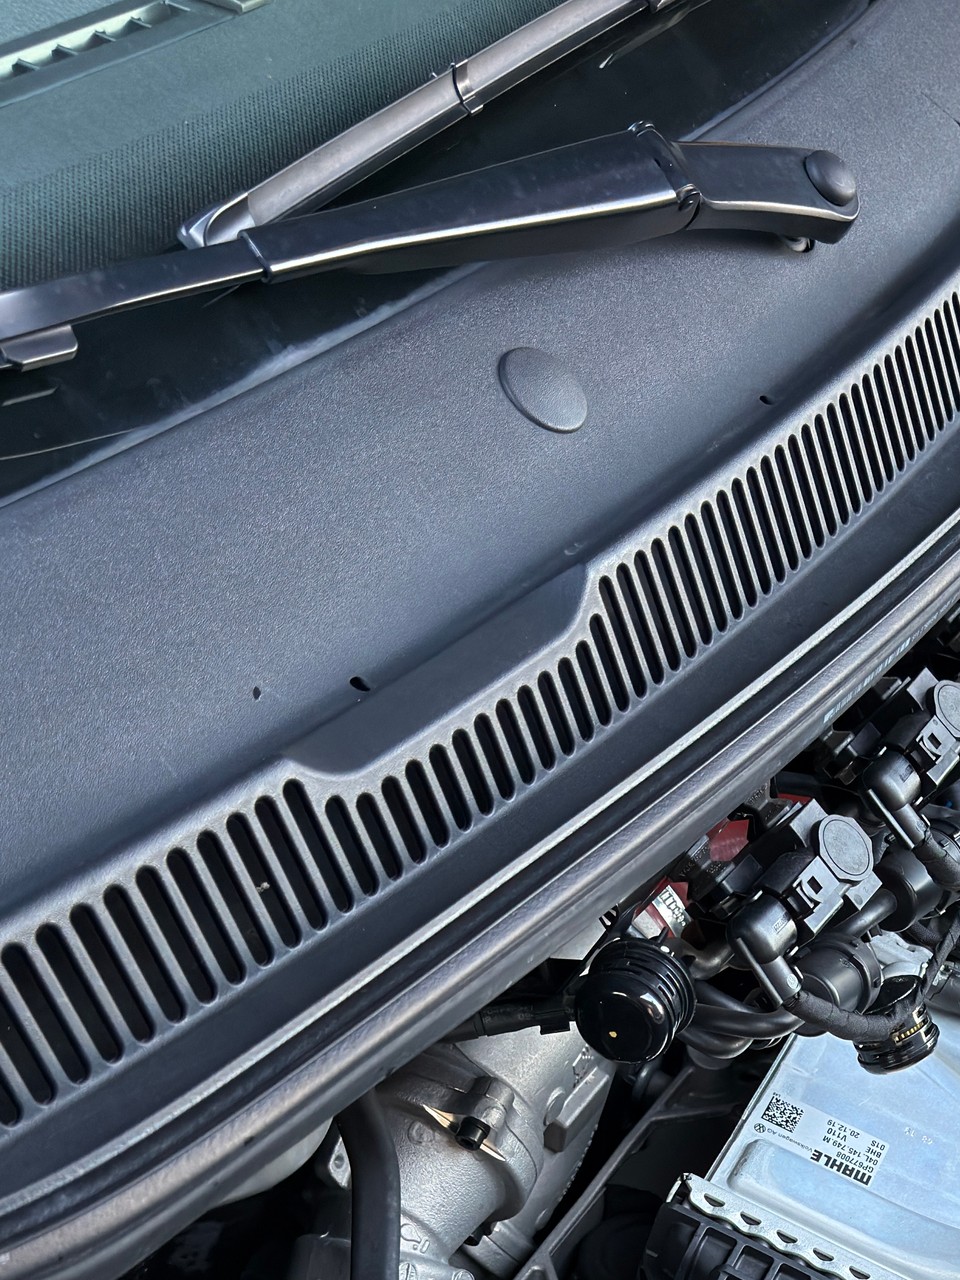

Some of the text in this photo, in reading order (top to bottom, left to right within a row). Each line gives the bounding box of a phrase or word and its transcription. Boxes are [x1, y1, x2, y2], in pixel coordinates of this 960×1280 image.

[826, 1127, 847, 1142] V110
[827, 1119, 860, 1139] 20.12.19
[777, 1133, 813, 1153] Volkswagen
[810, 1149, 872, 1186] MAHLE
[836, 1151, 874, 1173] GP677008
